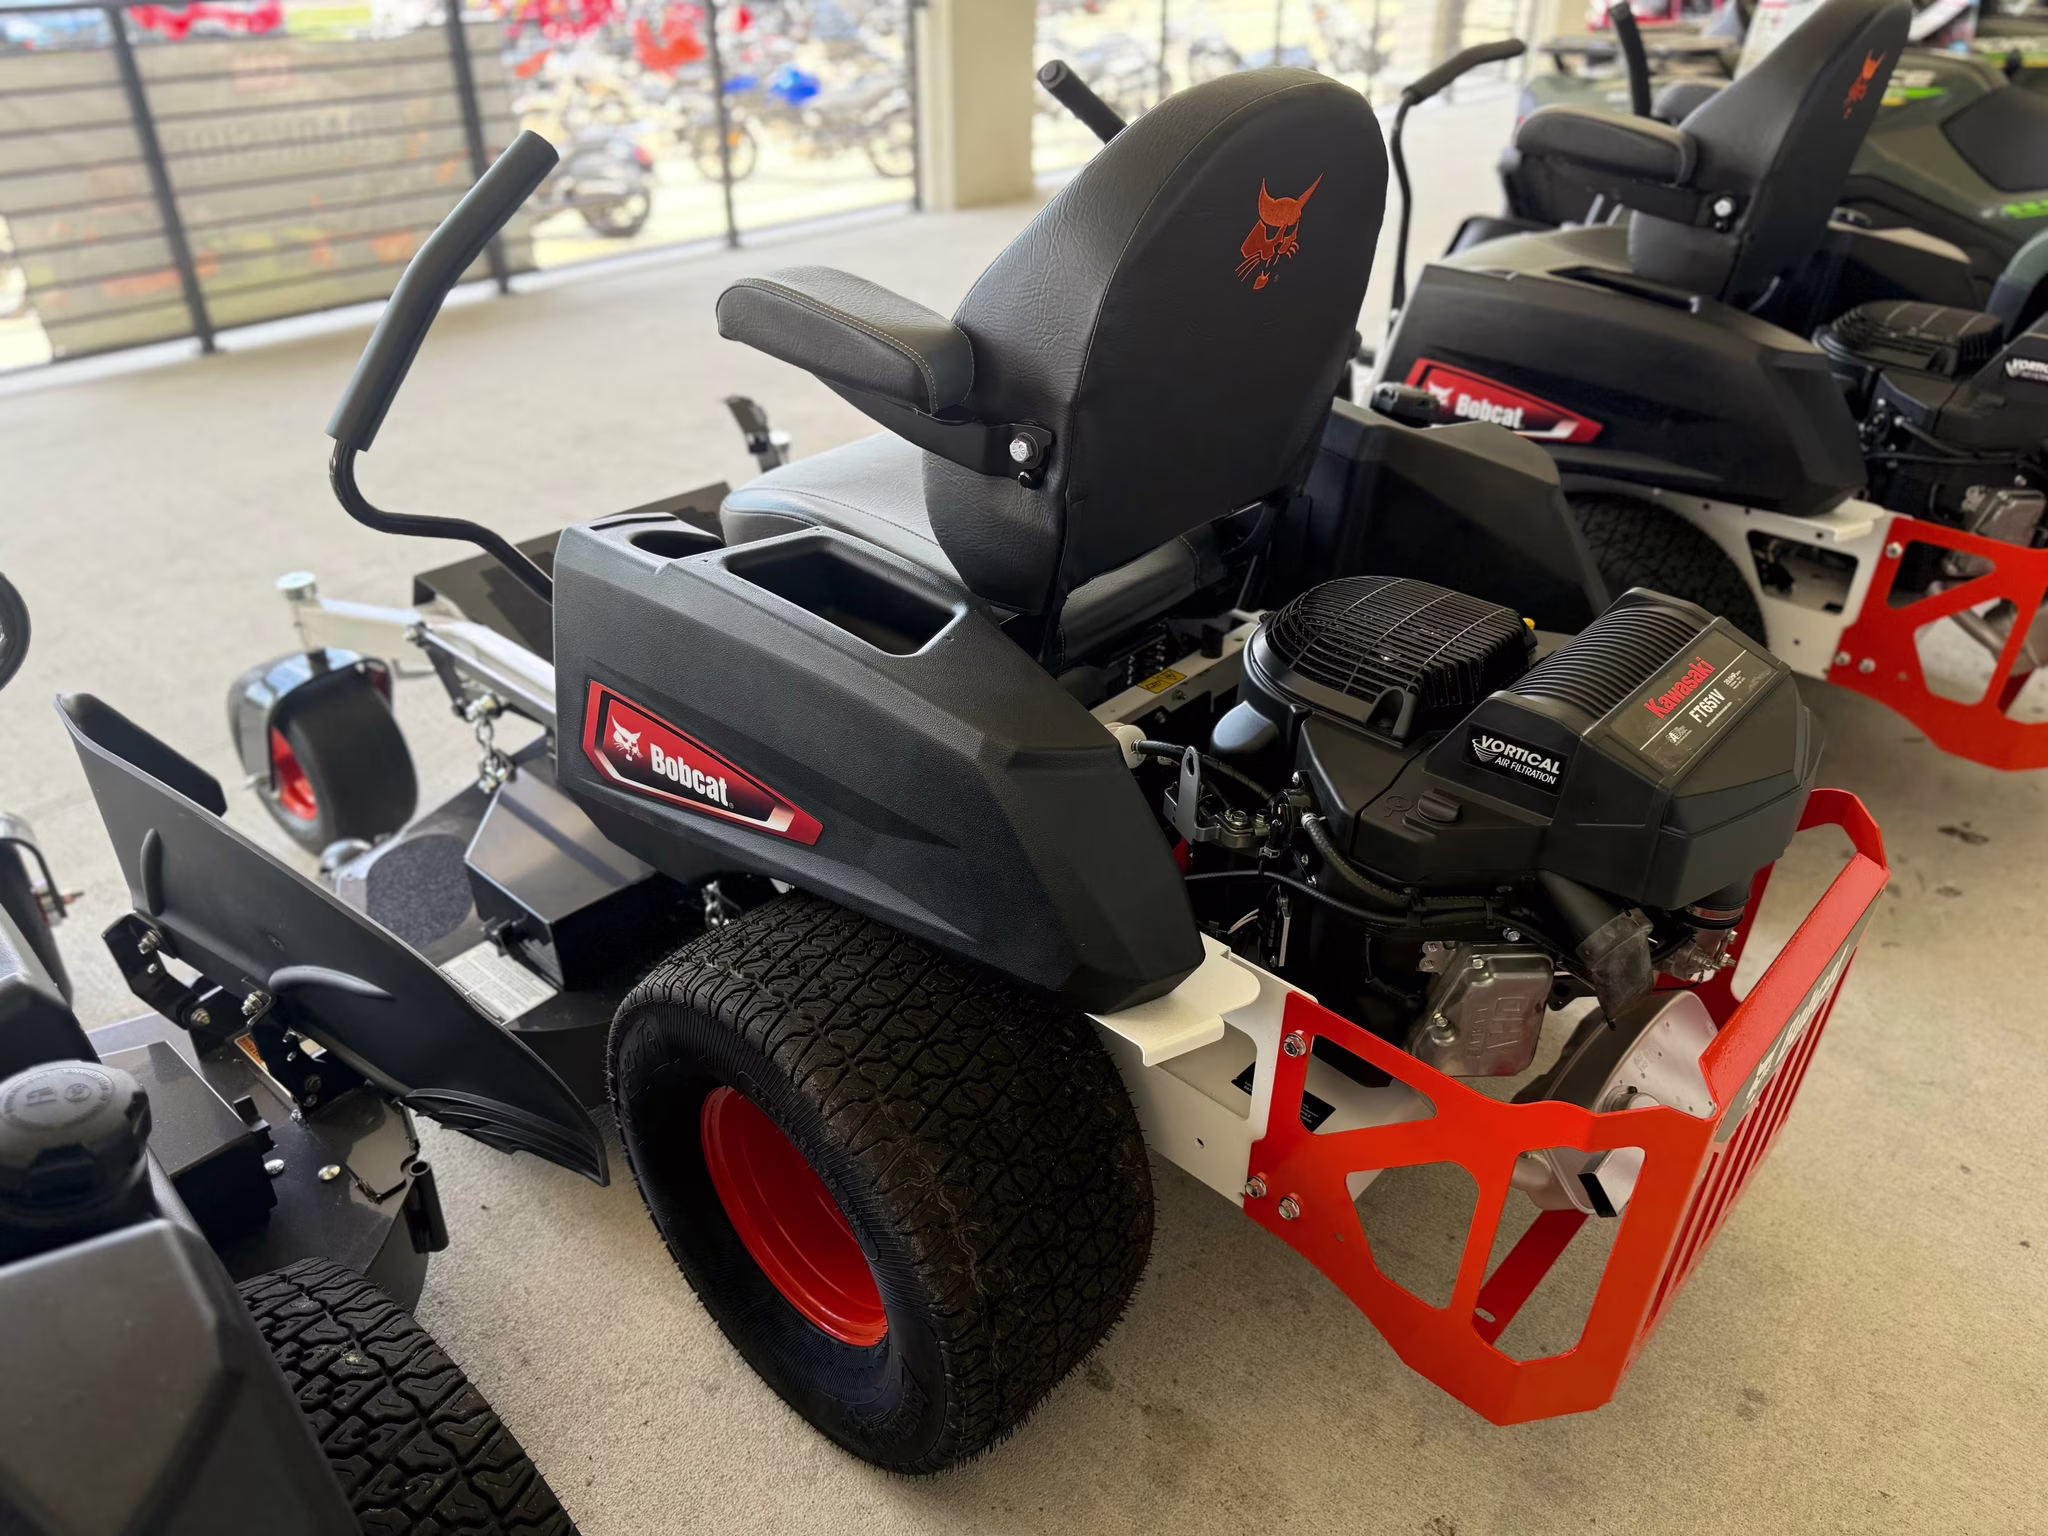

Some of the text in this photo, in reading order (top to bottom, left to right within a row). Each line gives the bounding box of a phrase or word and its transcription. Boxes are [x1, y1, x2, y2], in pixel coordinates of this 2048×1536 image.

[1455, 393, 1523, 429] Bobcat
[1643, 656, 1716, 719] Kawasaki
[1688, 688, 1725, 723] FT651V
[1481, 735, 1560, 774] VORTICAL
[1494, 756, 1557, 785] AIR FILTRATION
[650, 742, 729, 807] Bobcat
